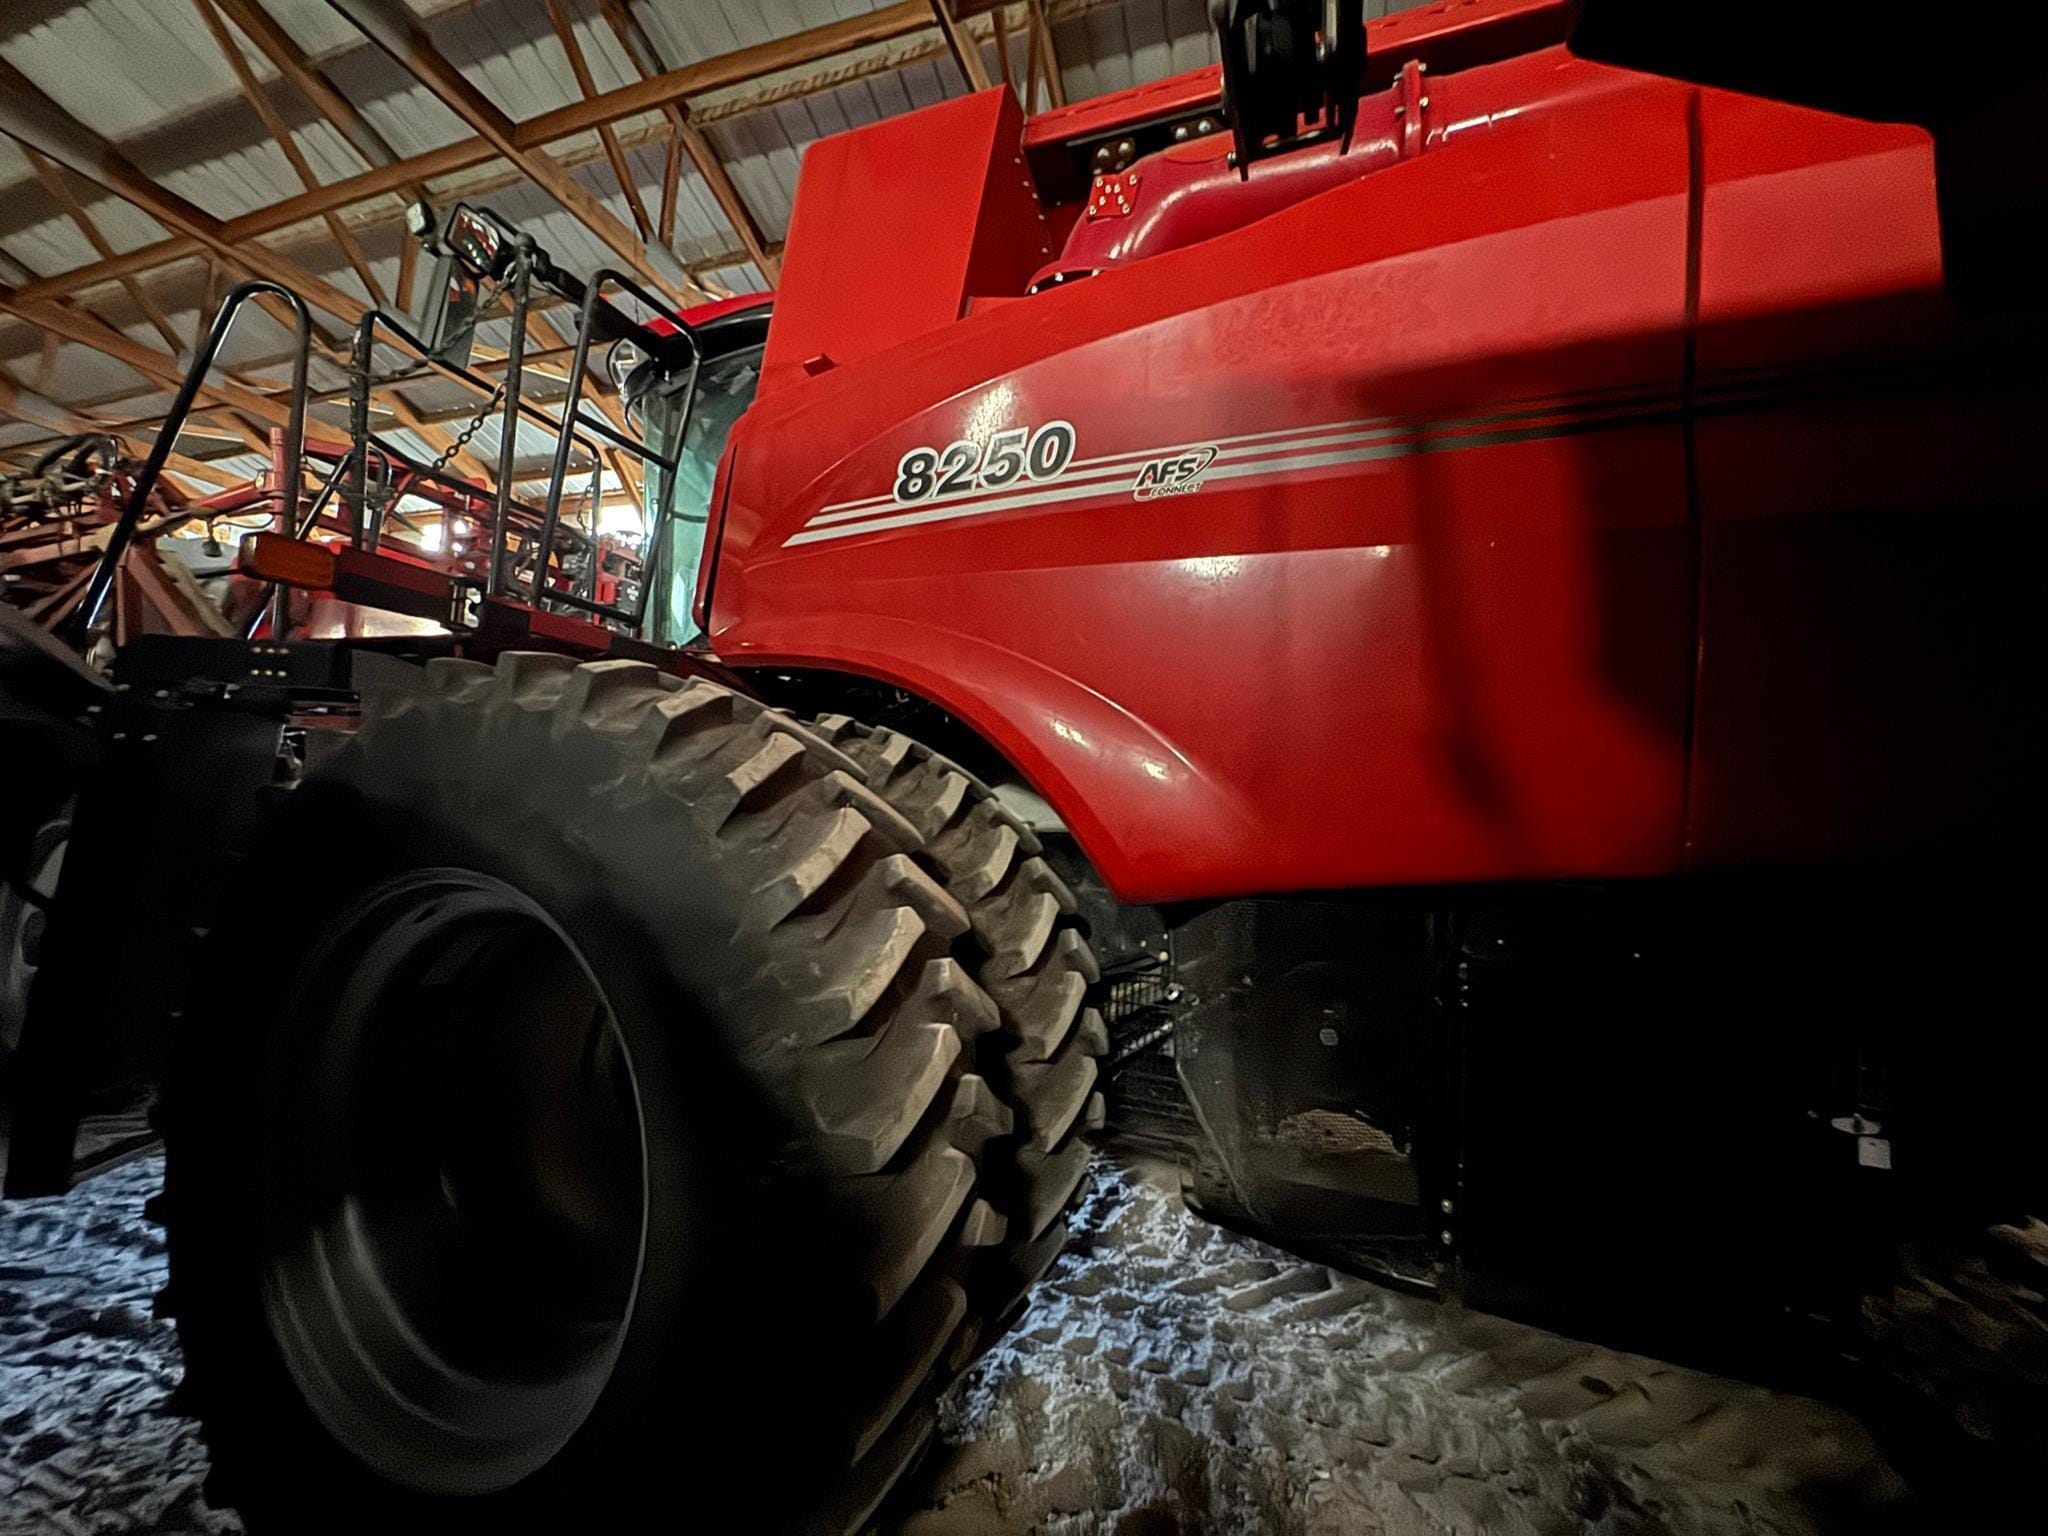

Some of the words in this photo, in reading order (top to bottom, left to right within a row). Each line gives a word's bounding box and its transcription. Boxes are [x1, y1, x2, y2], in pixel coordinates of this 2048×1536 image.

[895, 421, 1075, 503] 8250
[1135, 457, 1200, 488] AFS
[1150, 482, 1202, 497] CONNECT
